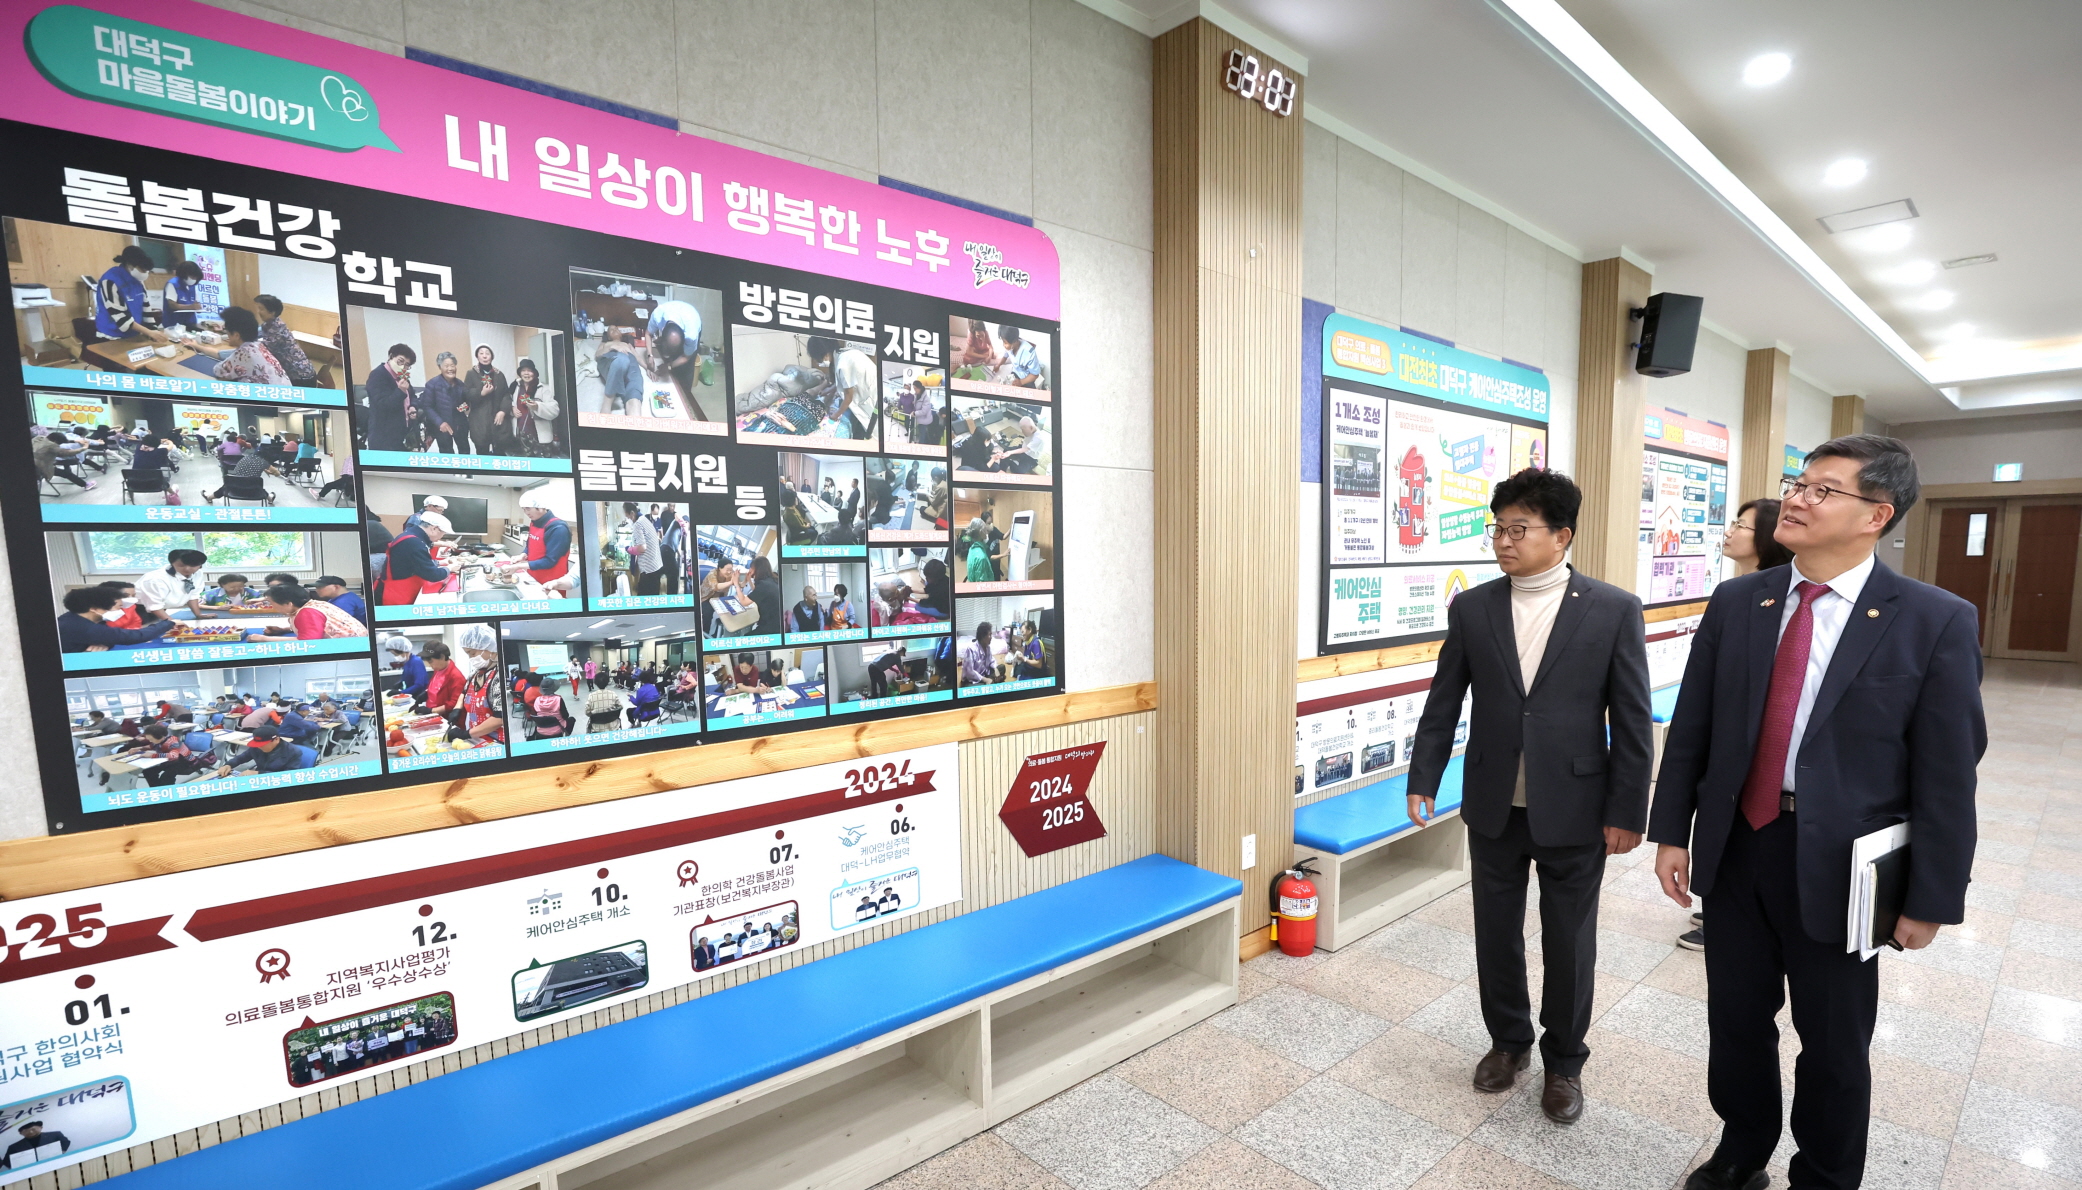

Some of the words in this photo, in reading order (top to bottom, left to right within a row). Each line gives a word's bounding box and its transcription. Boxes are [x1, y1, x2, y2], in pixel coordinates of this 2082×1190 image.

[94, 25, 193, 71] 대덕구
[97, 60, 316, 131] 마을돌봄이야기
[444, 114, 509, 182] 내
[534, 136, 704, 223] 일상이
[723, 181, 860, 255] 행복한
[876, 218, 950, 273] 노후
[62, 167, 340, 259] 돌봄건강
[342, 250, 457, 311] 학교
[965, 243, 977, 256] 내
[739, 281, 876, 339] 방문의료
[883, 324, 941, 365] 지원
[86, 374, 117, 388] 나의
[120, 375, 135, 389] 몸
[139, 377, 197, 394] 바로알기
[211, 380, 251, 397] 맞춤형
[254, 384, 305, 401] 건강관리
[1399, 353, 1438, 388] 대전최초
[1440, 364, 1467, 396] 대덕구
[1468, 372, 1531, 411] 케어안심주택조성
[1532, 388, 1546, 414] 운영
[1335, 402, 1360, 421] 1개소
[1362, 406, 1381, 425] 조성
[408, 456, 481, 469] 삼삼오오동아리
[492, 458, 532, 470] 종이접기
[577, 449, 729, 494] 돌봄지원
[734, 485, 767, 520] 등
[145, 507, 201, 521] 운동교실
[215, 507, 272, 520] 관절튼튼!
[598, 597, 624, 609] 깨끗한
[625, 597, 642, 608] 집은
[643, 596, 668, 606] 건강의
[669, 594, 686, 605] 시작
[1334, 577, 1381, 600] 케어안심
[412, 605, 434, 617] 이젠
[436, 603, 478, 616] 남자들도
[480, 602, 519, 614] 요리교실
[521, 601, 551, 611] 다녀요
[1358, 602, 1381, 624] 주택
[711, 638, 733, 648] 어르신
[811, 631, 832, 642] 도시락
[832, 629, 865, 640] 감사합니다
[131, 647, 174, 664] 선생님
[177, 645, 204, 661] 말씀
[283, 642, 317, 654] 하나~
[773, 711, 795, 721] 어려워
[1347, 718, 1357, 729] 10.
[551, 735, 581, 748] 하하하!
[583, 732, 610, 746] 웃으면
[612, 727, 667, 743] 건강해집니다~
[391, 756, 412, 769] 즐거운
[441, 751, 460, 764] 오늘의
[460, 749, 478, 762] 요리는
[479, 747, 502, 760] 닭볶음탕
[107, 792, 133, 807] 뇌도
[136, 787, 173, 803] 운동이
[176, 780, 239, 800] 필요합니다!
[248, 773, 293, 790] 인지능력
[295, 770, 315, 785] 향상
[318, 764, 359, 781] 수업시간
[843, 759, 915, 799] 2024
[1029, 774, 1073, 803] 2024
[890, 816, 916, 836] 06.
[1042, 801, 1084, 831] 2025
[769, 844, 799, 865] 07.
[841, 846, 911, 873] 대덕-LH업무협약
[860, 836, 911, 857] 케어안심주택
[591, 883, 628, 906] 10.
[700, 877, 733, 897] 한의학
[734, 865, 794, 889] 건강돌봄사업
[673, 876, 795, 917] 기관표창(보건복지부장관)
[0, 903, 108, 964] 25
[412, 920, 457, 947] 12.
[526, 908, 604, 939] 케어안심주택
[606, 905, 631, 923] 개소
[326, 946, 451, 986] 지역복지사업평가
[64, 993, 130, 1026] 01.
[224, 982, 362, 1027] 의료돌봄통합지원
[318, 1028, 329, 1038] 내
[331, 1020, 359, 1035] 일상이
[361, 1013, 389, 1027] 즐거운
[391, 1004, 417, 1019] 대덕구
[0, 1044, 28, 1066] 구
[35, 1023, 121, 1056] 한의사회
[60, 1040, 123, 1069] 협약식
[57, 1081, 124, 1107] 대덕구
